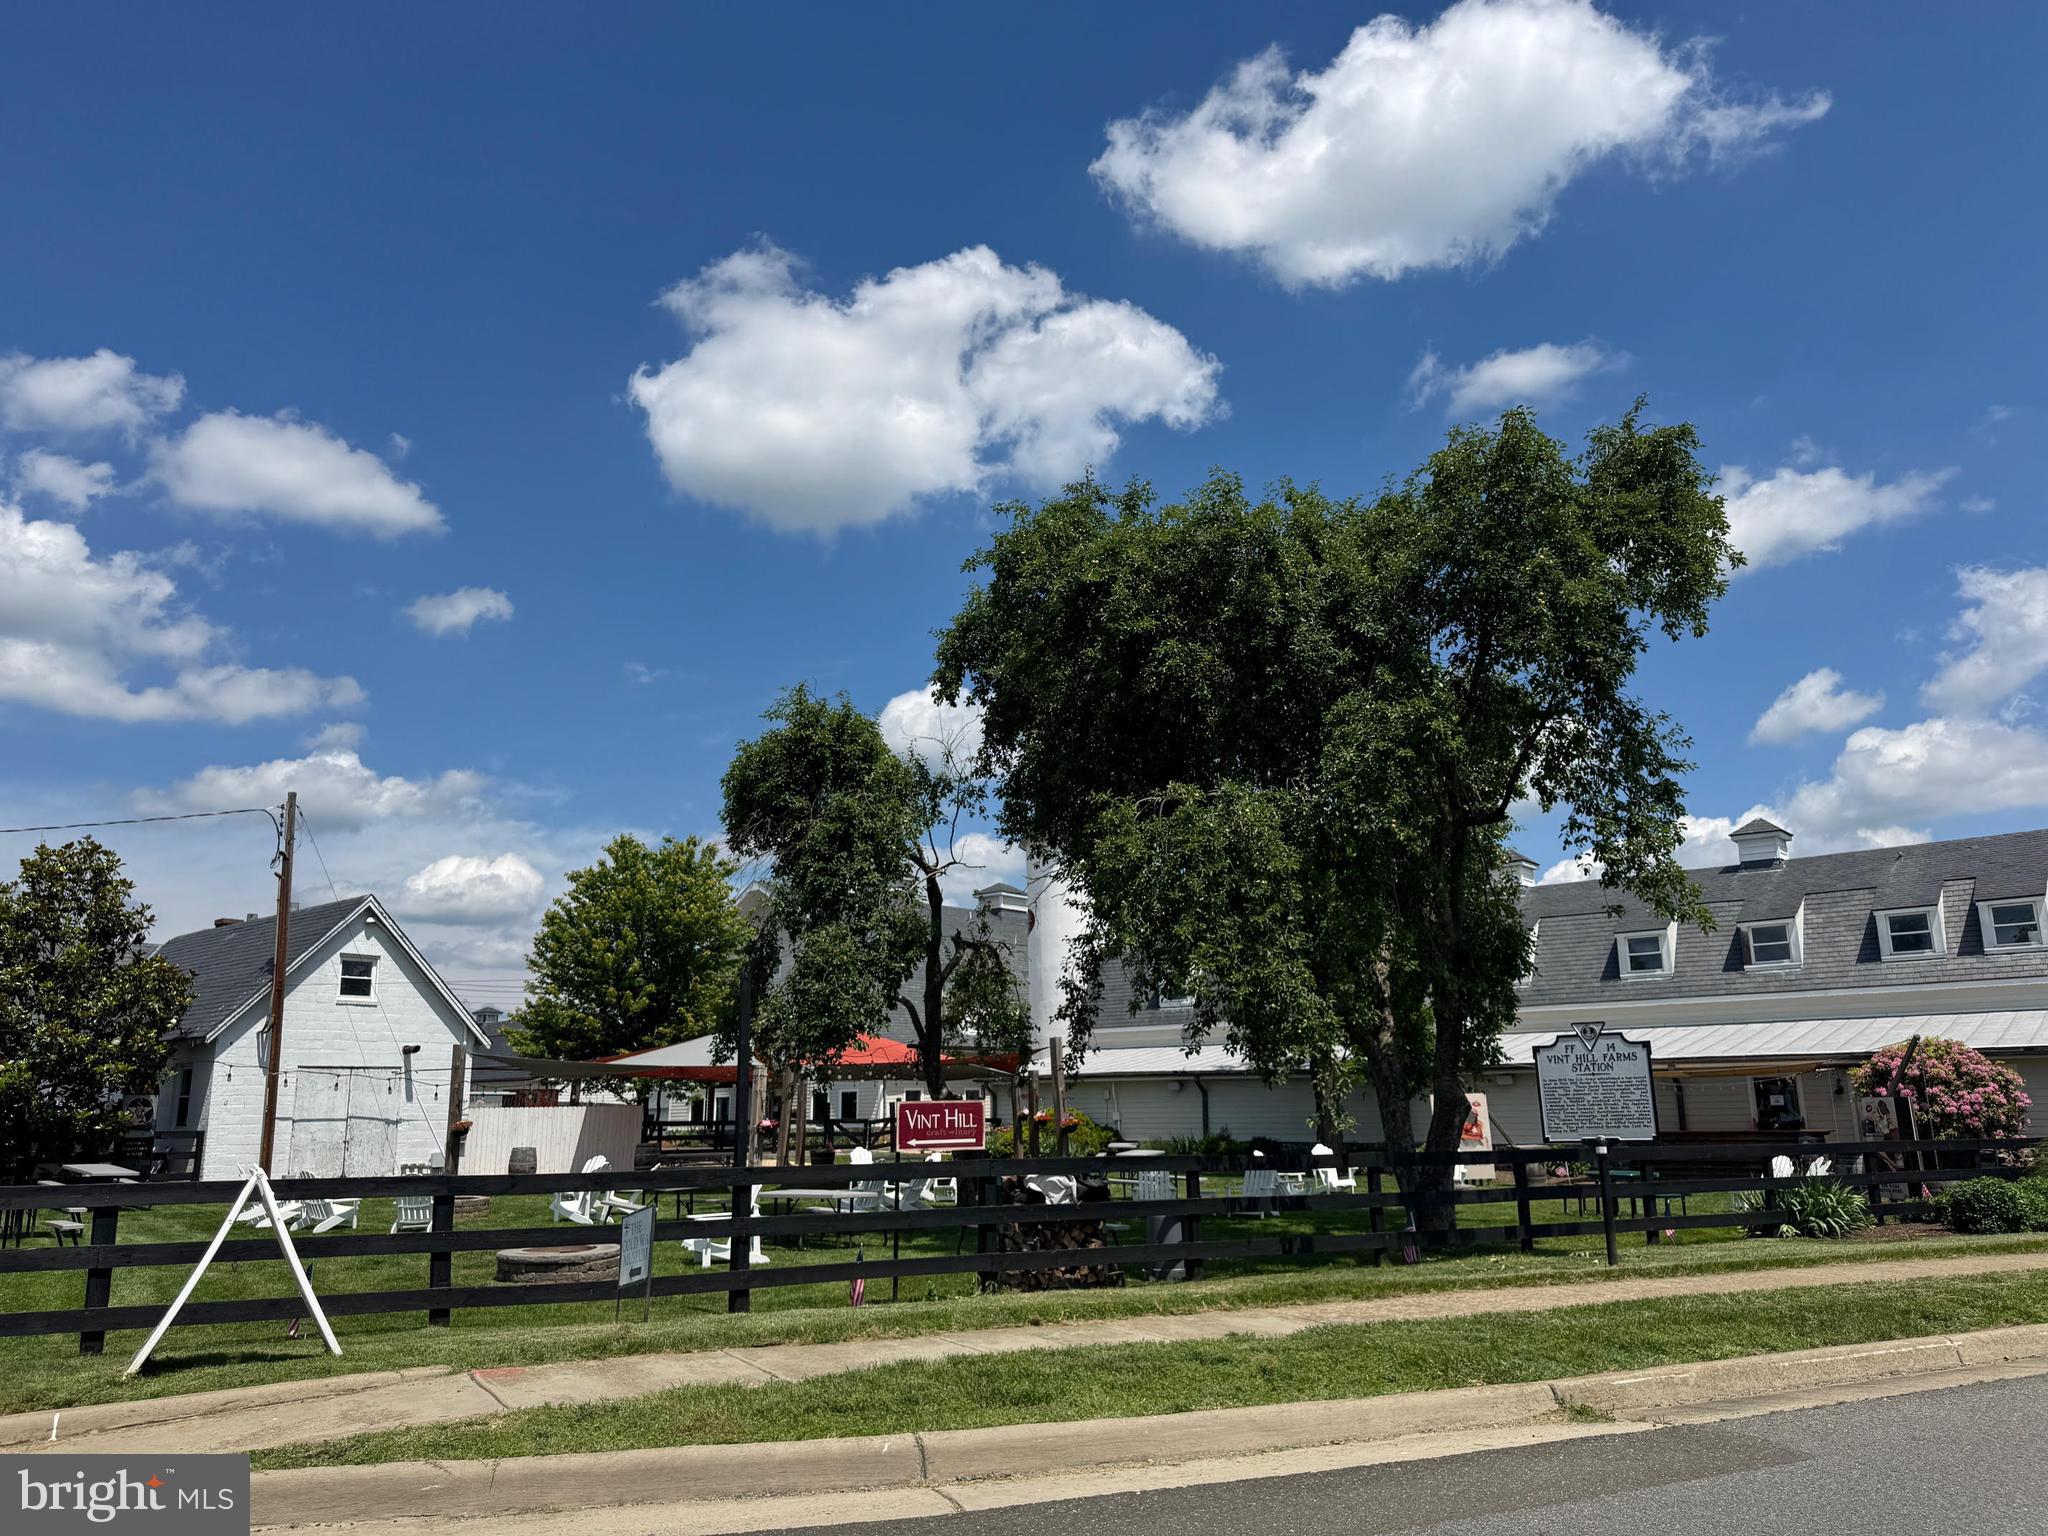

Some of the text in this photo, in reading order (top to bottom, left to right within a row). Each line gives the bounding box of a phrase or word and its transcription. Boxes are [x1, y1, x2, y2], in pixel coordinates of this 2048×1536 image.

[1564, 1042, 1617, 1054] FF 14
[1546, 1051, 1638, 1064] VINT HILL FARMS
[1571, 1062, 1614, 1073] STATION
[905, 1108, 978, 1130] VINT HILL
[926, 1127, 977, 1137] craft winery
[631, 1220, 642, 1236] THE
